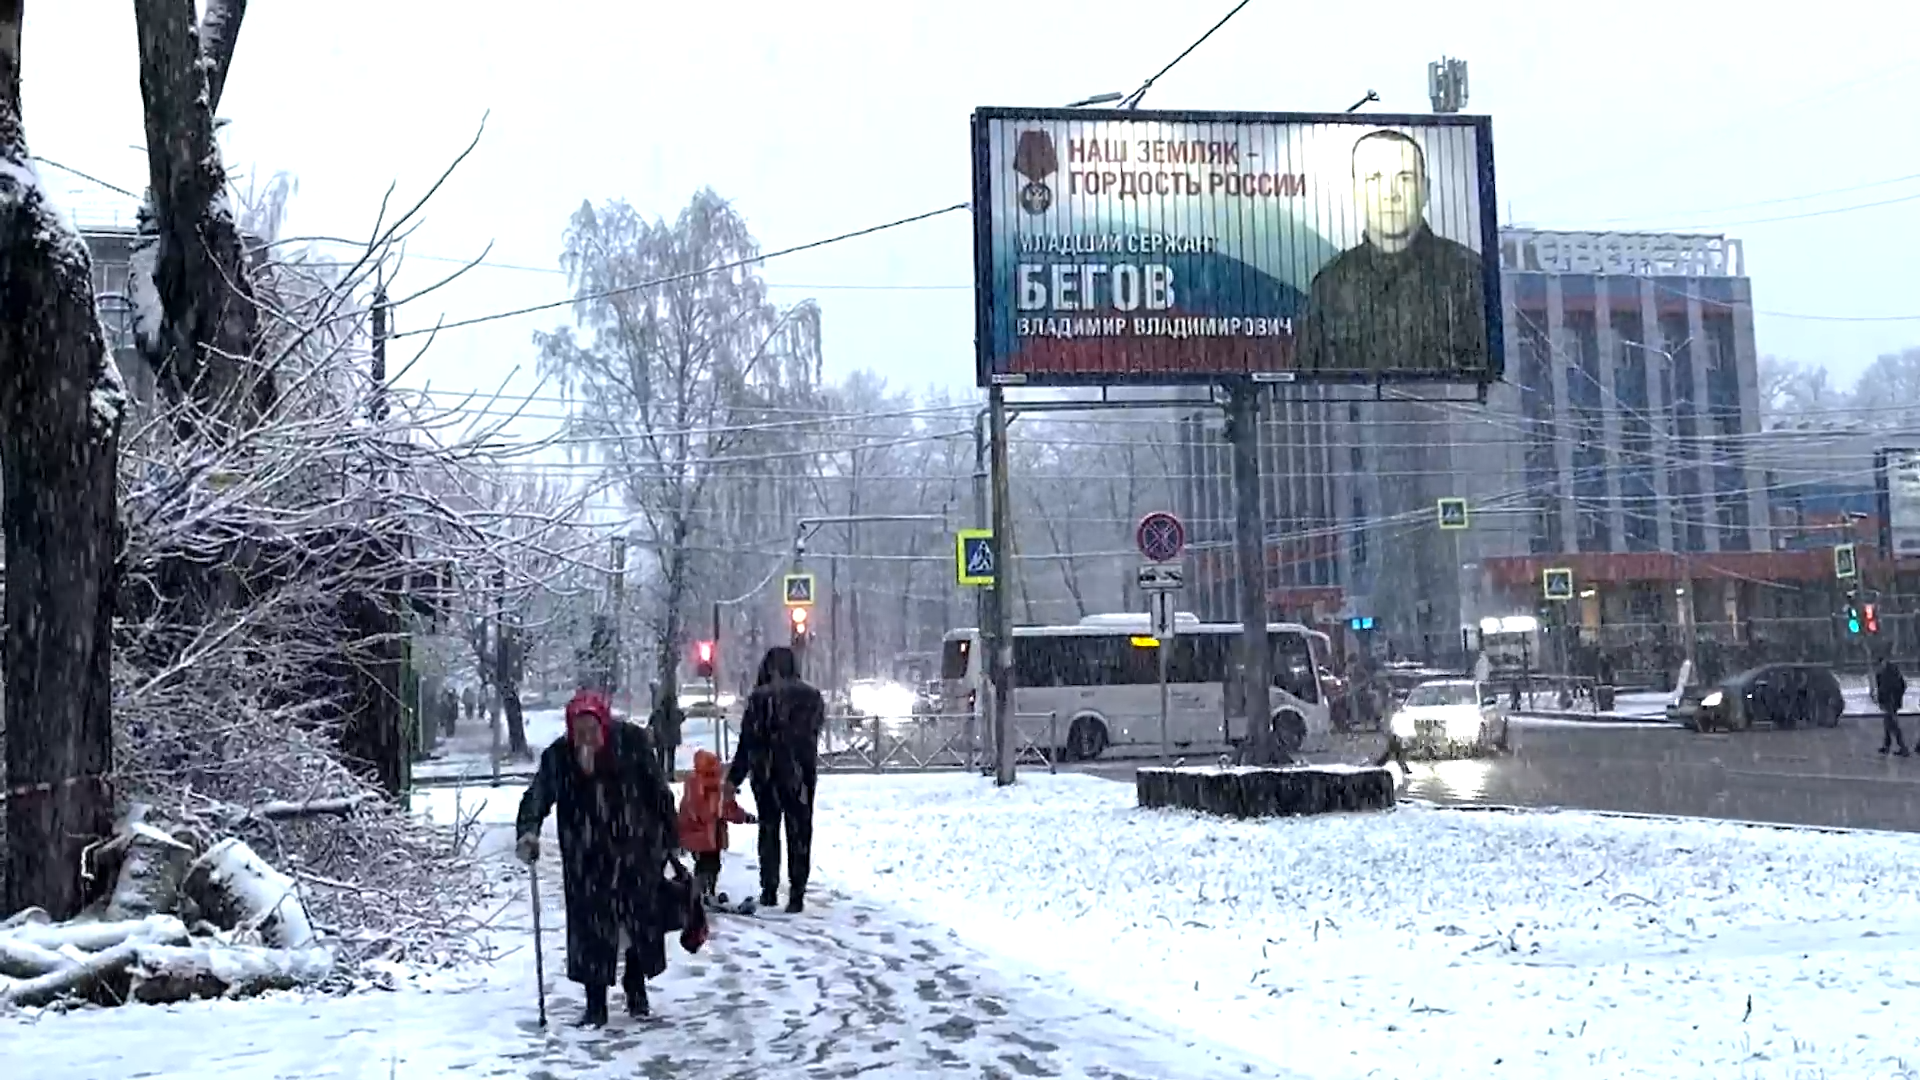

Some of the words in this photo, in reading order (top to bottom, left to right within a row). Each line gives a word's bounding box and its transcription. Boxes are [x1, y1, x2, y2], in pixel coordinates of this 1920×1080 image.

[1070, 138, 1127, 164] НАШ
[1137, 139, 1240, 165] ЗЕМЛЯК
[1070, 171, 1201, 200] ГОРДОСТЬ
[1208, 172, 1307, 197] РОССИИ
[1017, 262, 1175, 312] БЕГОВ
[1017, 317, 1126, 338] ВЛАДИМИР
[1134, 317, 1293, 337] ВЛАДИМИРОВИЧ
